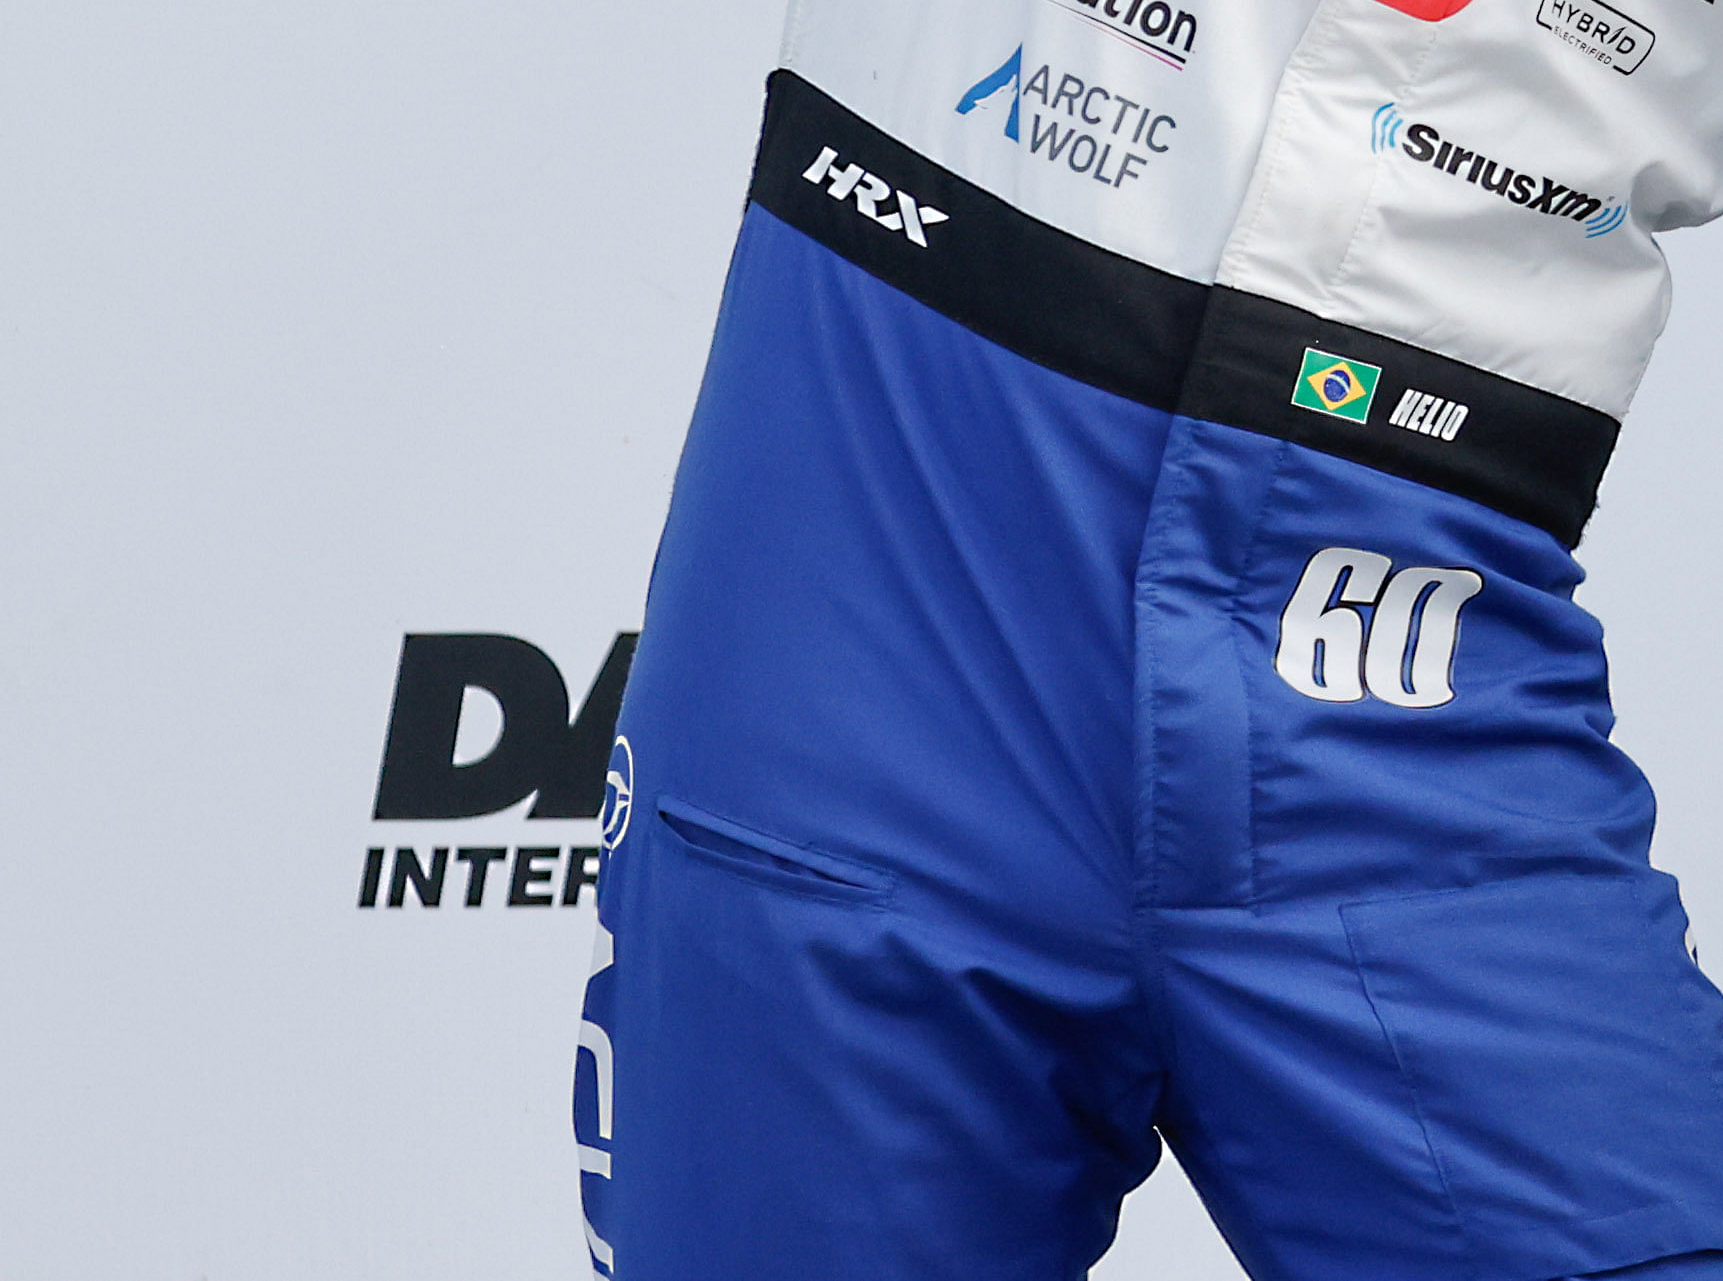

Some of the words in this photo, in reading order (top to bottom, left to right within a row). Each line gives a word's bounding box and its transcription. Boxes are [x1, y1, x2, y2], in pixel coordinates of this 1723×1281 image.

[1554, 26, 1613, 65] ELECTRIFIED
[1021, 64, 1177, 154] ARCTIC
[1028, 112, 1150, 191] WOLF
[800, 146, 949, 248] HRX
[1387, 387, 1471, 443] HELIO
[1274, 546, 1483, 709] 60
